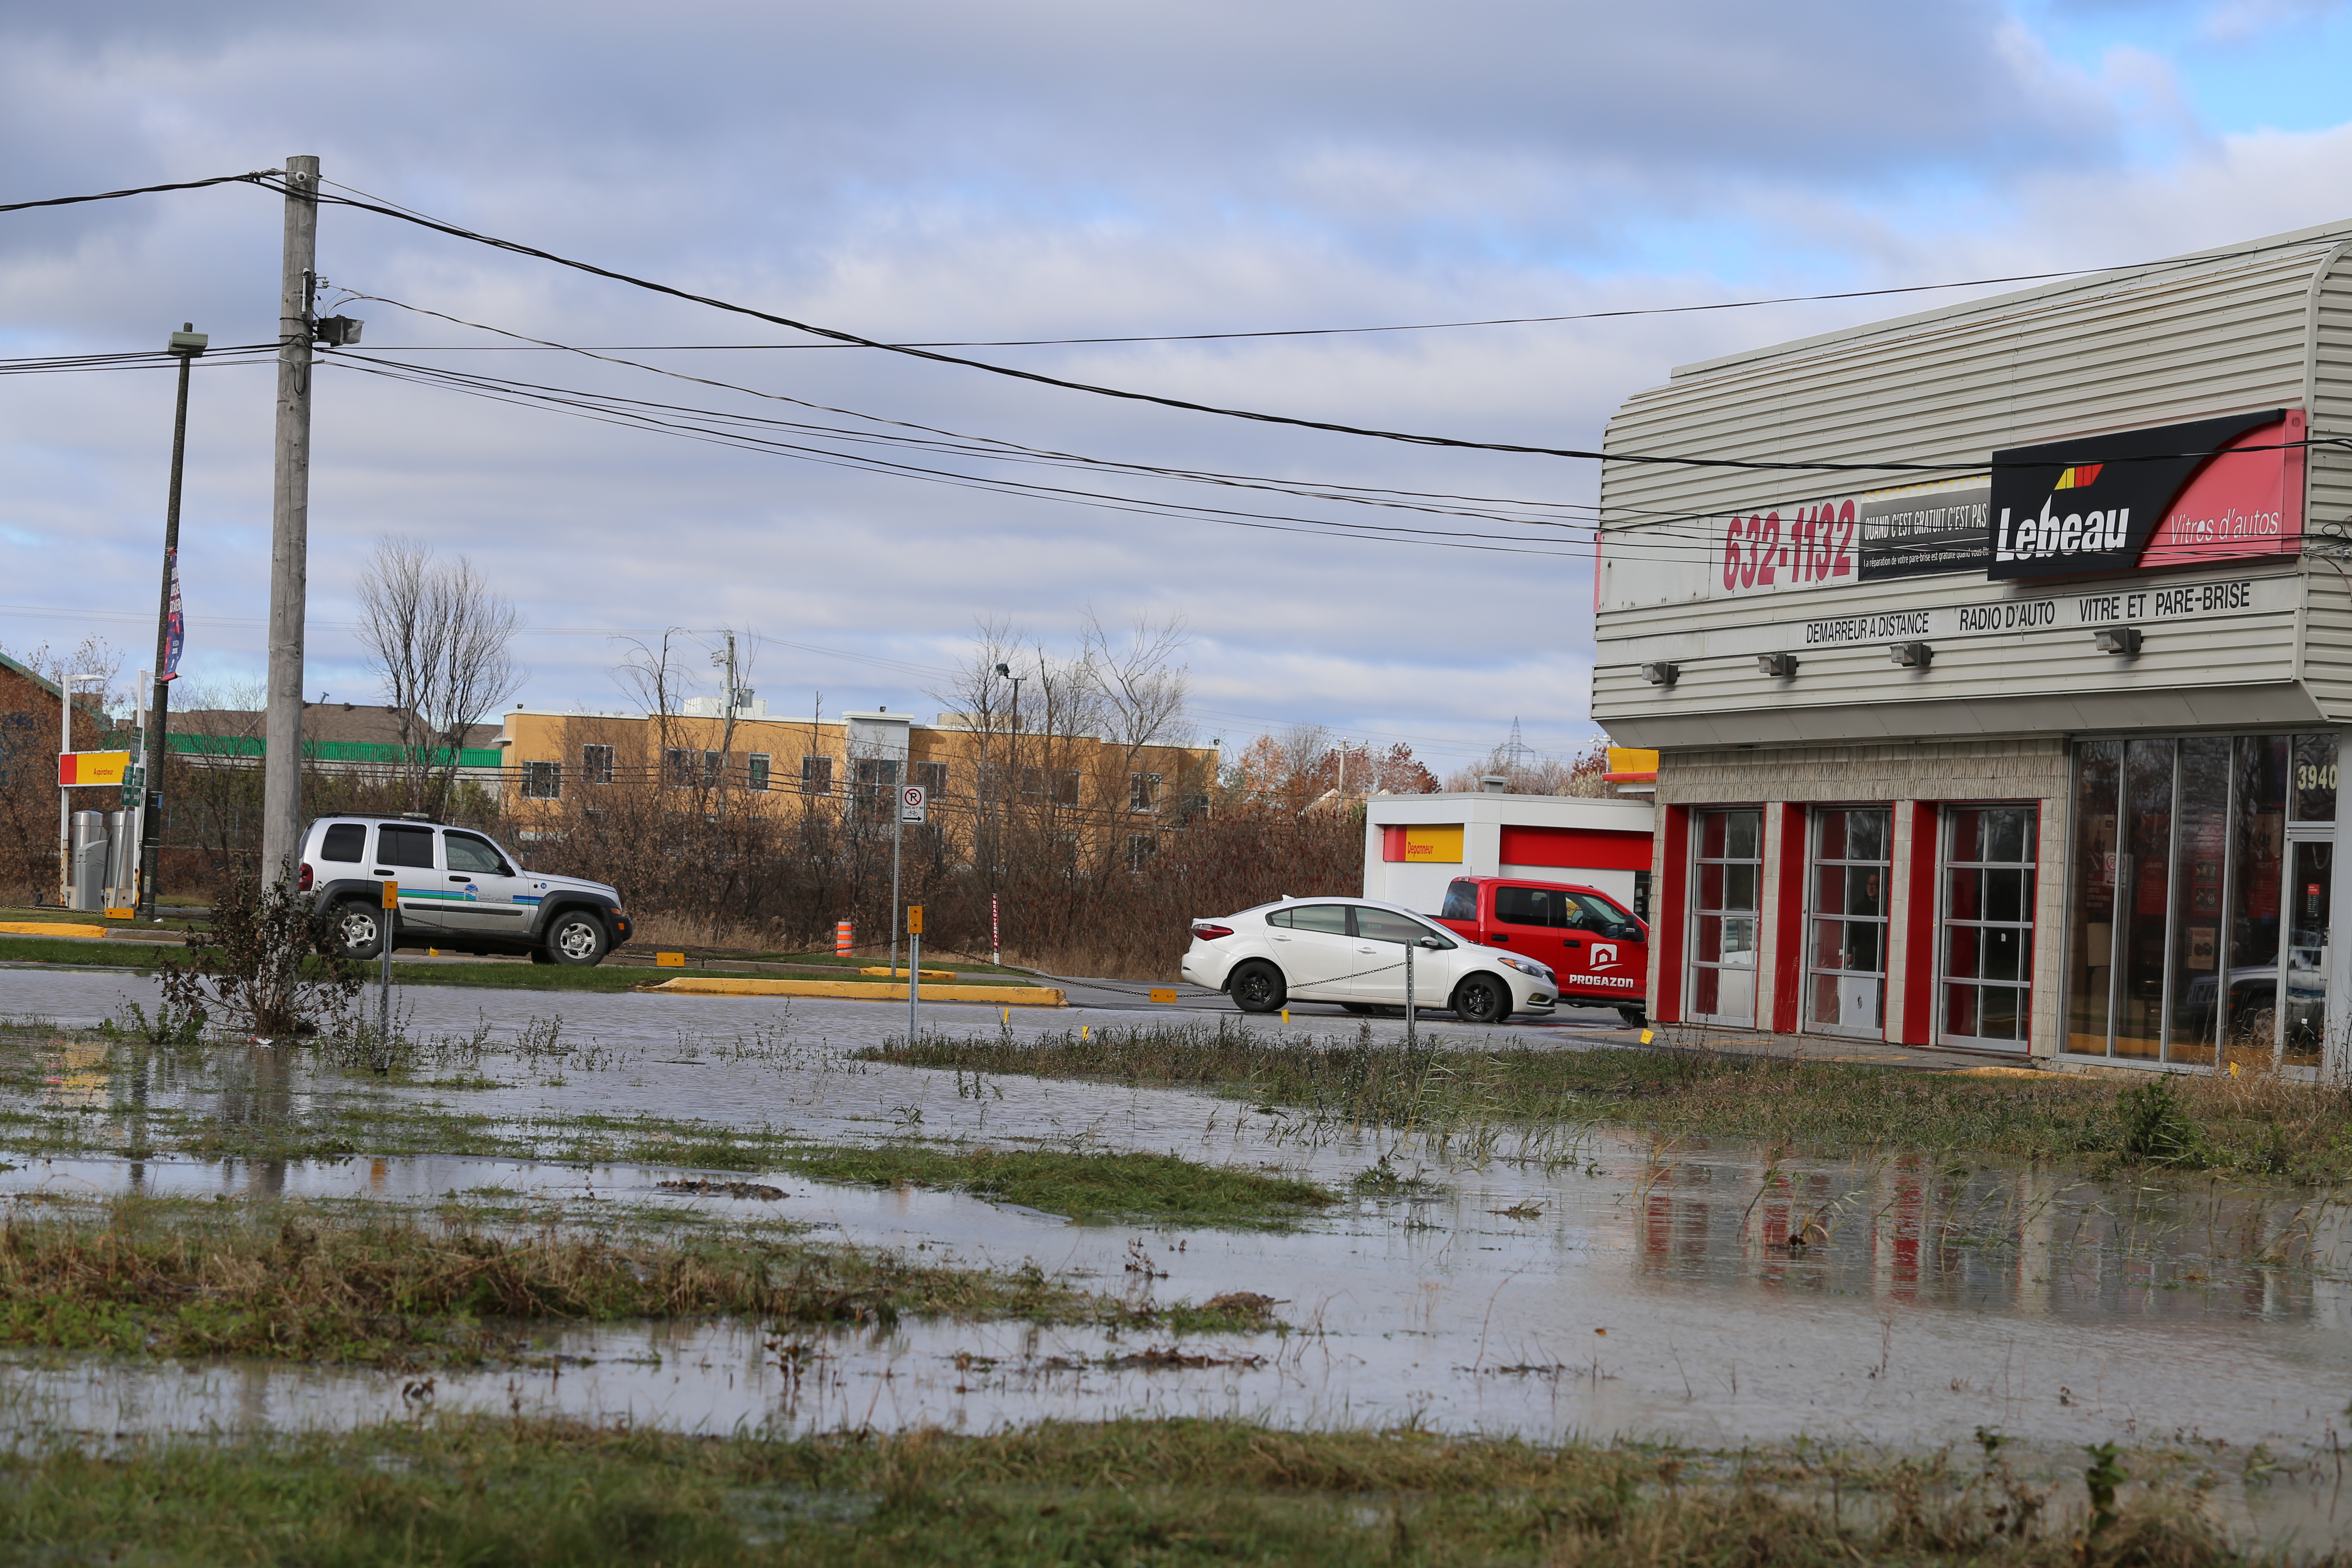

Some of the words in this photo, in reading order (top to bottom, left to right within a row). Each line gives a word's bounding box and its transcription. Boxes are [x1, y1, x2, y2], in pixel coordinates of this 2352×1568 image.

[1865, 514, 1889, 541] QUAND
[1891, 512, 1913, 538] C'EST
[1914, 507, 1946, 536] GRATUIT
[1948, 504, 1970, 532] C'EST
[1971, 502, 1988, 529] PAS
[1995, 494, 2130, 562] Lebeau
[2171, 513, 2214, 545] Vitres
[2218, 507, 2279, 540] d'autos
[1723, 499, 1855, 591] 632-1132
[1864, 559, 1869, 567] La
[1869, 556, 1891, 569] réparation
[1891, 556, 1897, 565] de
[1897, 556, 1909, 564] votre
[1909, 552, 1931, 564] pare-brise
[1939, 551, 1956, 563] gratuite
[1960, 606, 2001, 631] RADIO
[2005, 601, 2055, 628] D'AUTO
[2079, 596, 2120, 622] VITRE
[2127, 594, 2147, 619] ET
[2155, 582, 2251, 616] PARE-BRISE
[1806, 619, 1867, 643] DEMARREUR
[1869, 618, 1876, 638] A
[1878, 612, 1929, 637] DISTANCE
[131, 742, 140, 758] 132
[93, 767, 113, 778] Aspirateur
[125, 770, 133, 780] EST
[2297, 764, 2338, 790] 3940
[1408, 841, 1433, 858] Dépanneur
[1569, 974, 1634, 988] PROGAZON
